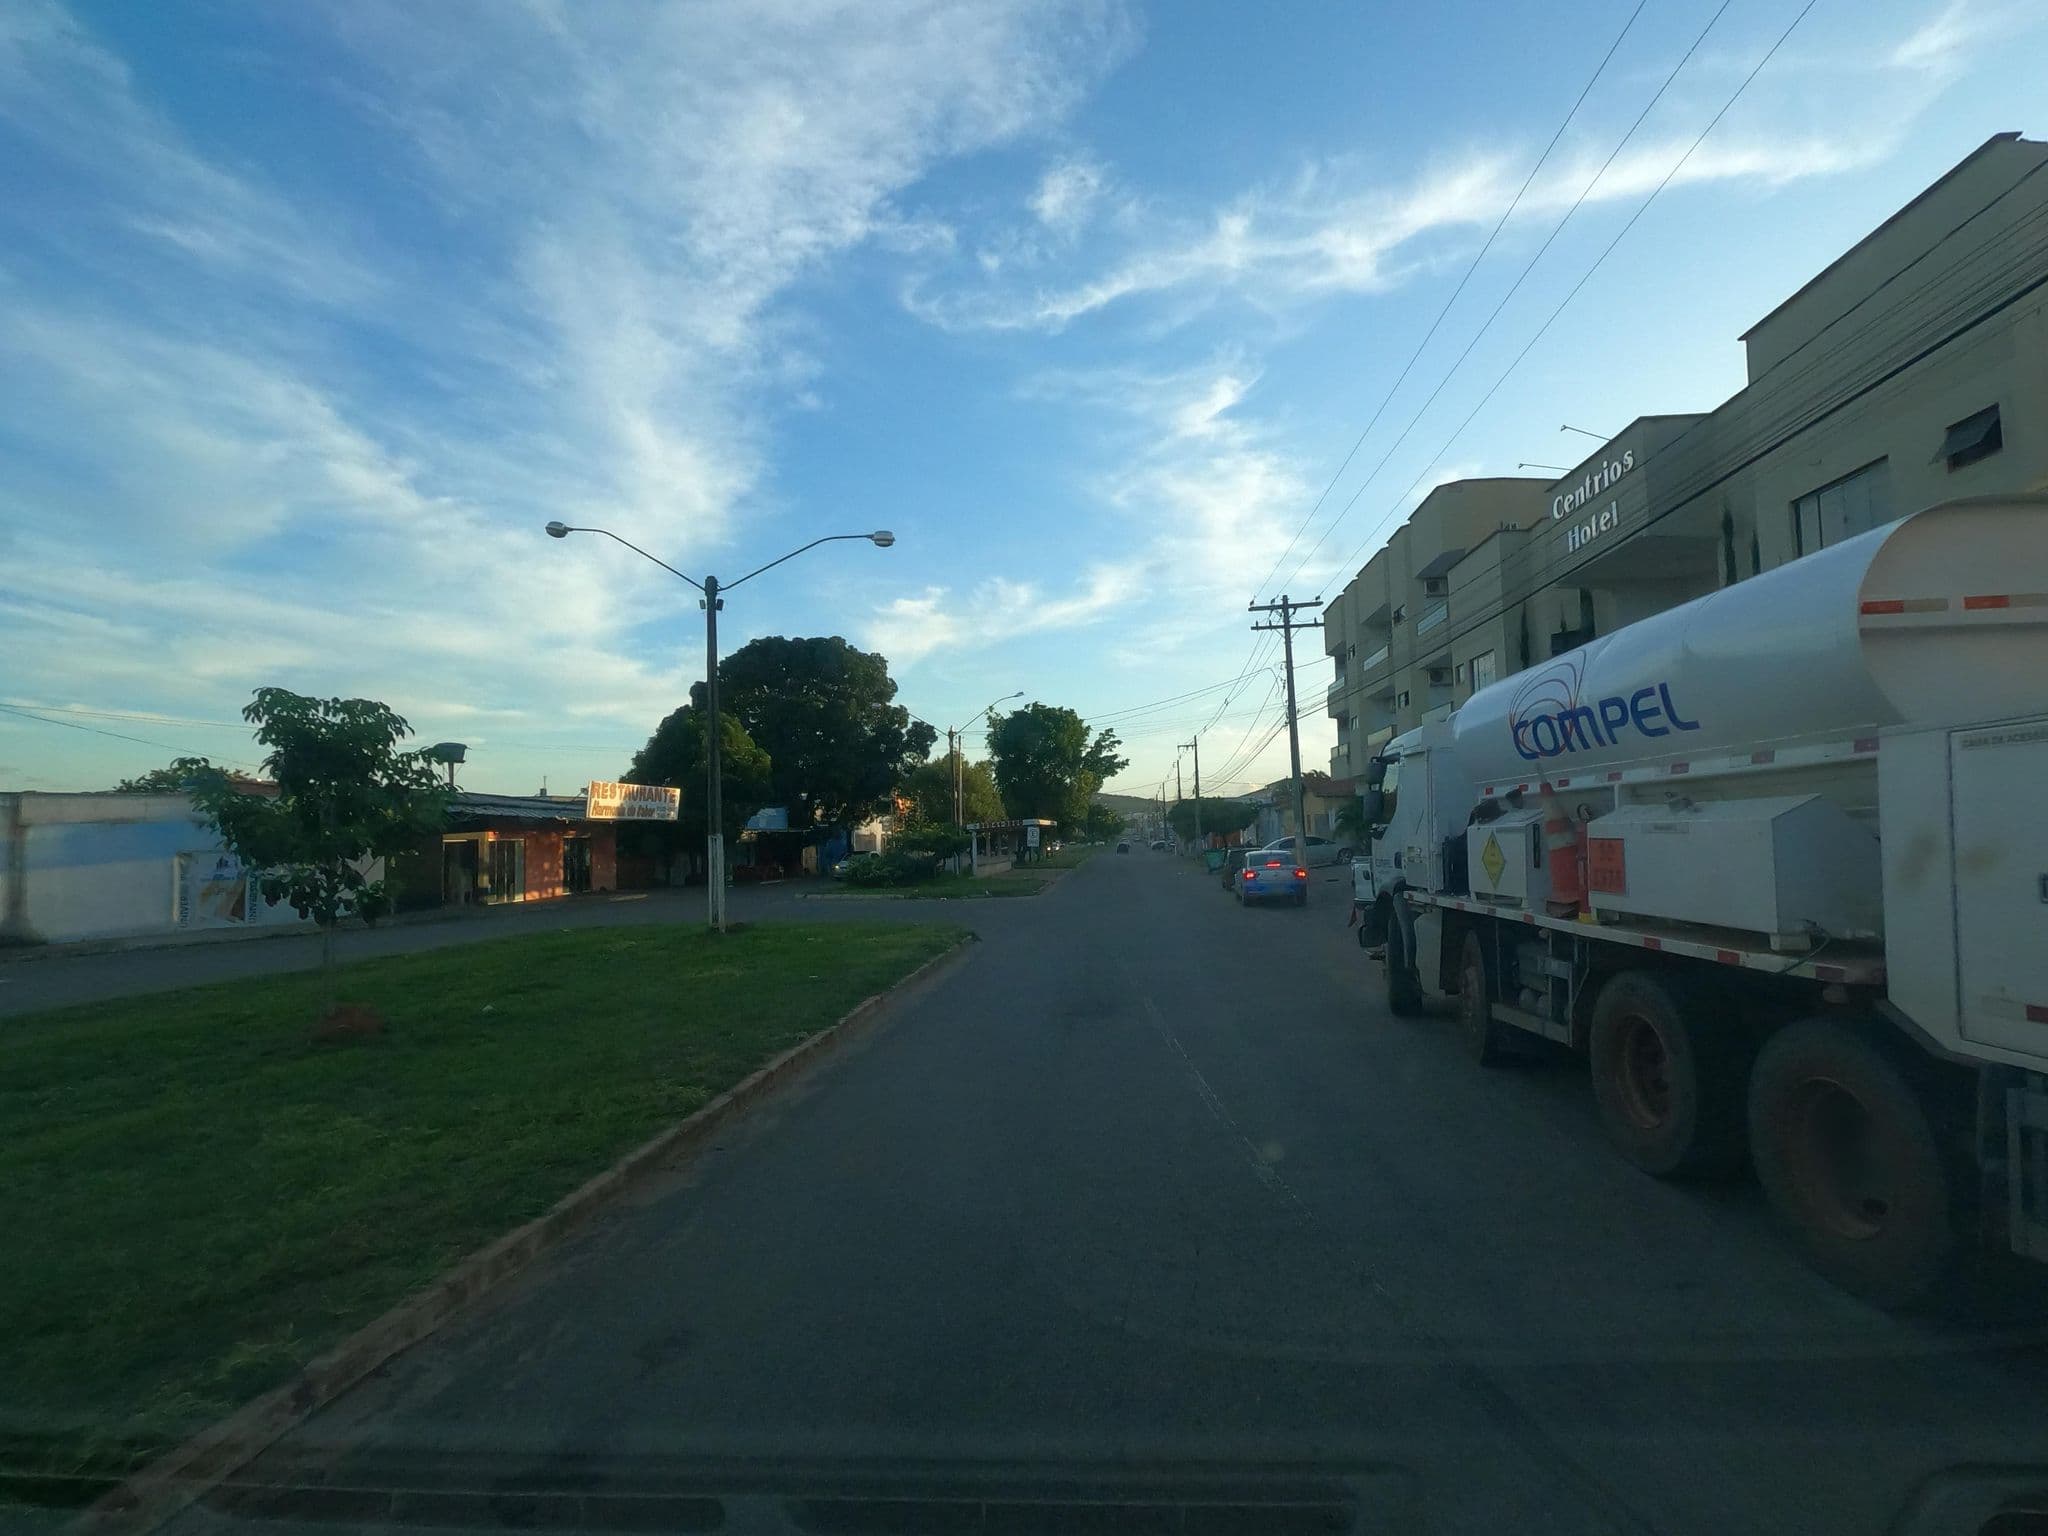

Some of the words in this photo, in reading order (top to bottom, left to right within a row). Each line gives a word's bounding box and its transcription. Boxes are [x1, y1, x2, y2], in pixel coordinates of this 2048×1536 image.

[1552, 450, 1634, 519] Centrios
[1567, 501, 1619, 553] Hotel
[1513, 682, 1700, 760] COMPEL
[591, 782, 678, 804] RESTAURANTE
